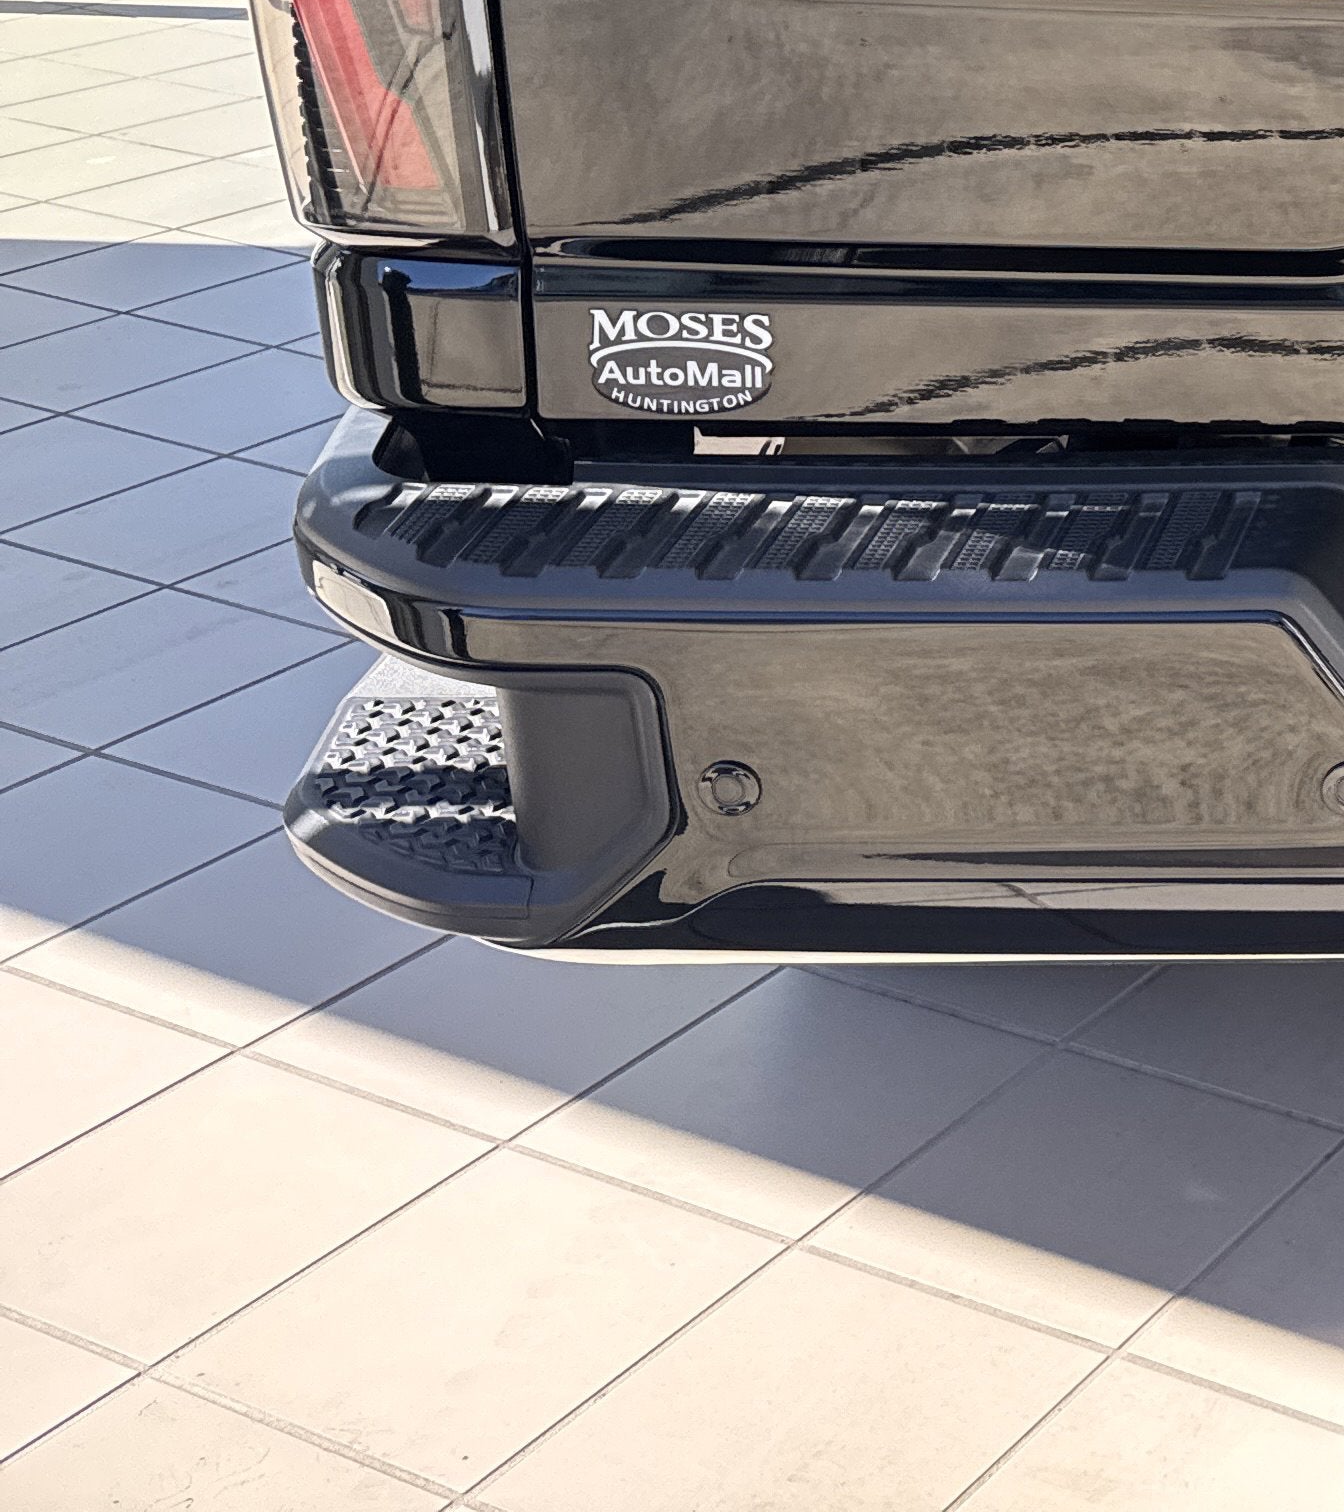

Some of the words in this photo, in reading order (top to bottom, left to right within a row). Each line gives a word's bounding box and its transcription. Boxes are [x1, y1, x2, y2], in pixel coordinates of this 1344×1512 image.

[589, 309, 773, 350] MOSES
[597, 359, 763, 388] AutoMall
[611, 387, 753, 414] HUNTINGTON
